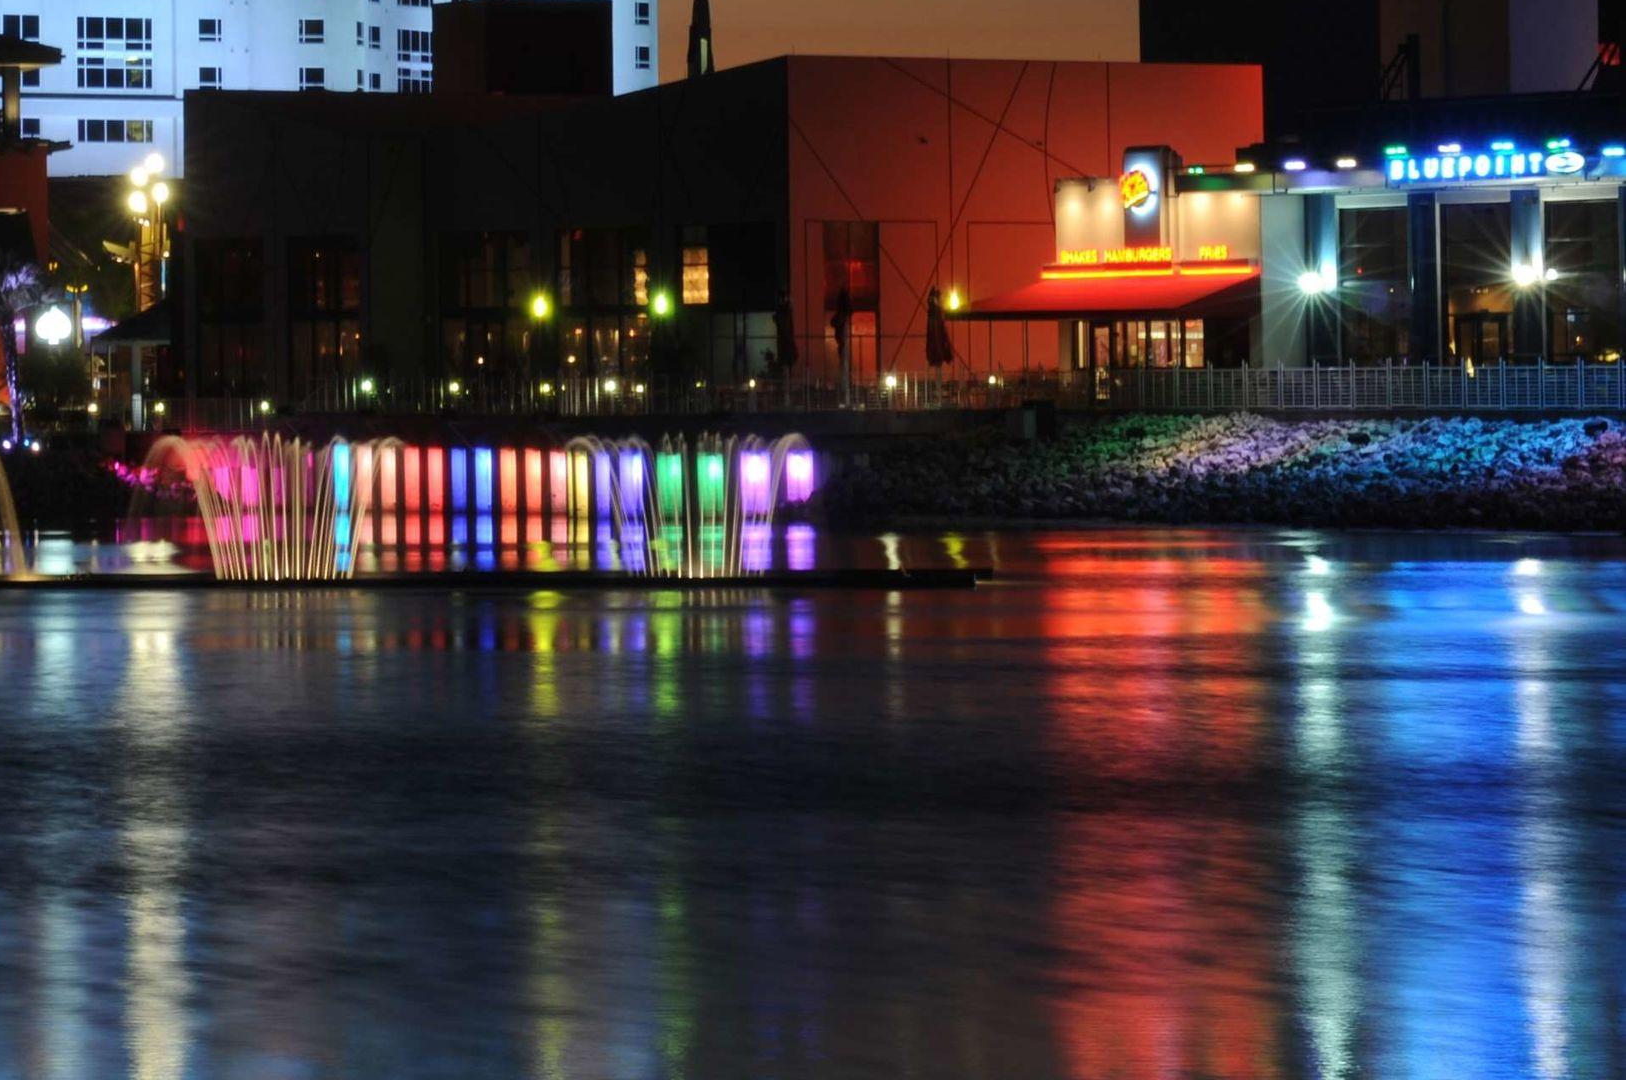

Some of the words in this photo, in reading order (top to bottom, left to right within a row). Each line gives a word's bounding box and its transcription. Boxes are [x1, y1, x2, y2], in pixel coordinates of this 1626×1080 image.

[1389, 152, 1543, 181] BLUEPOINT
[1060, 249, 1098, 264] SHAKES
[1104, 247, 1172, 262] HAMBURGERS
[1198, 245, 1228, 260] FRIES
